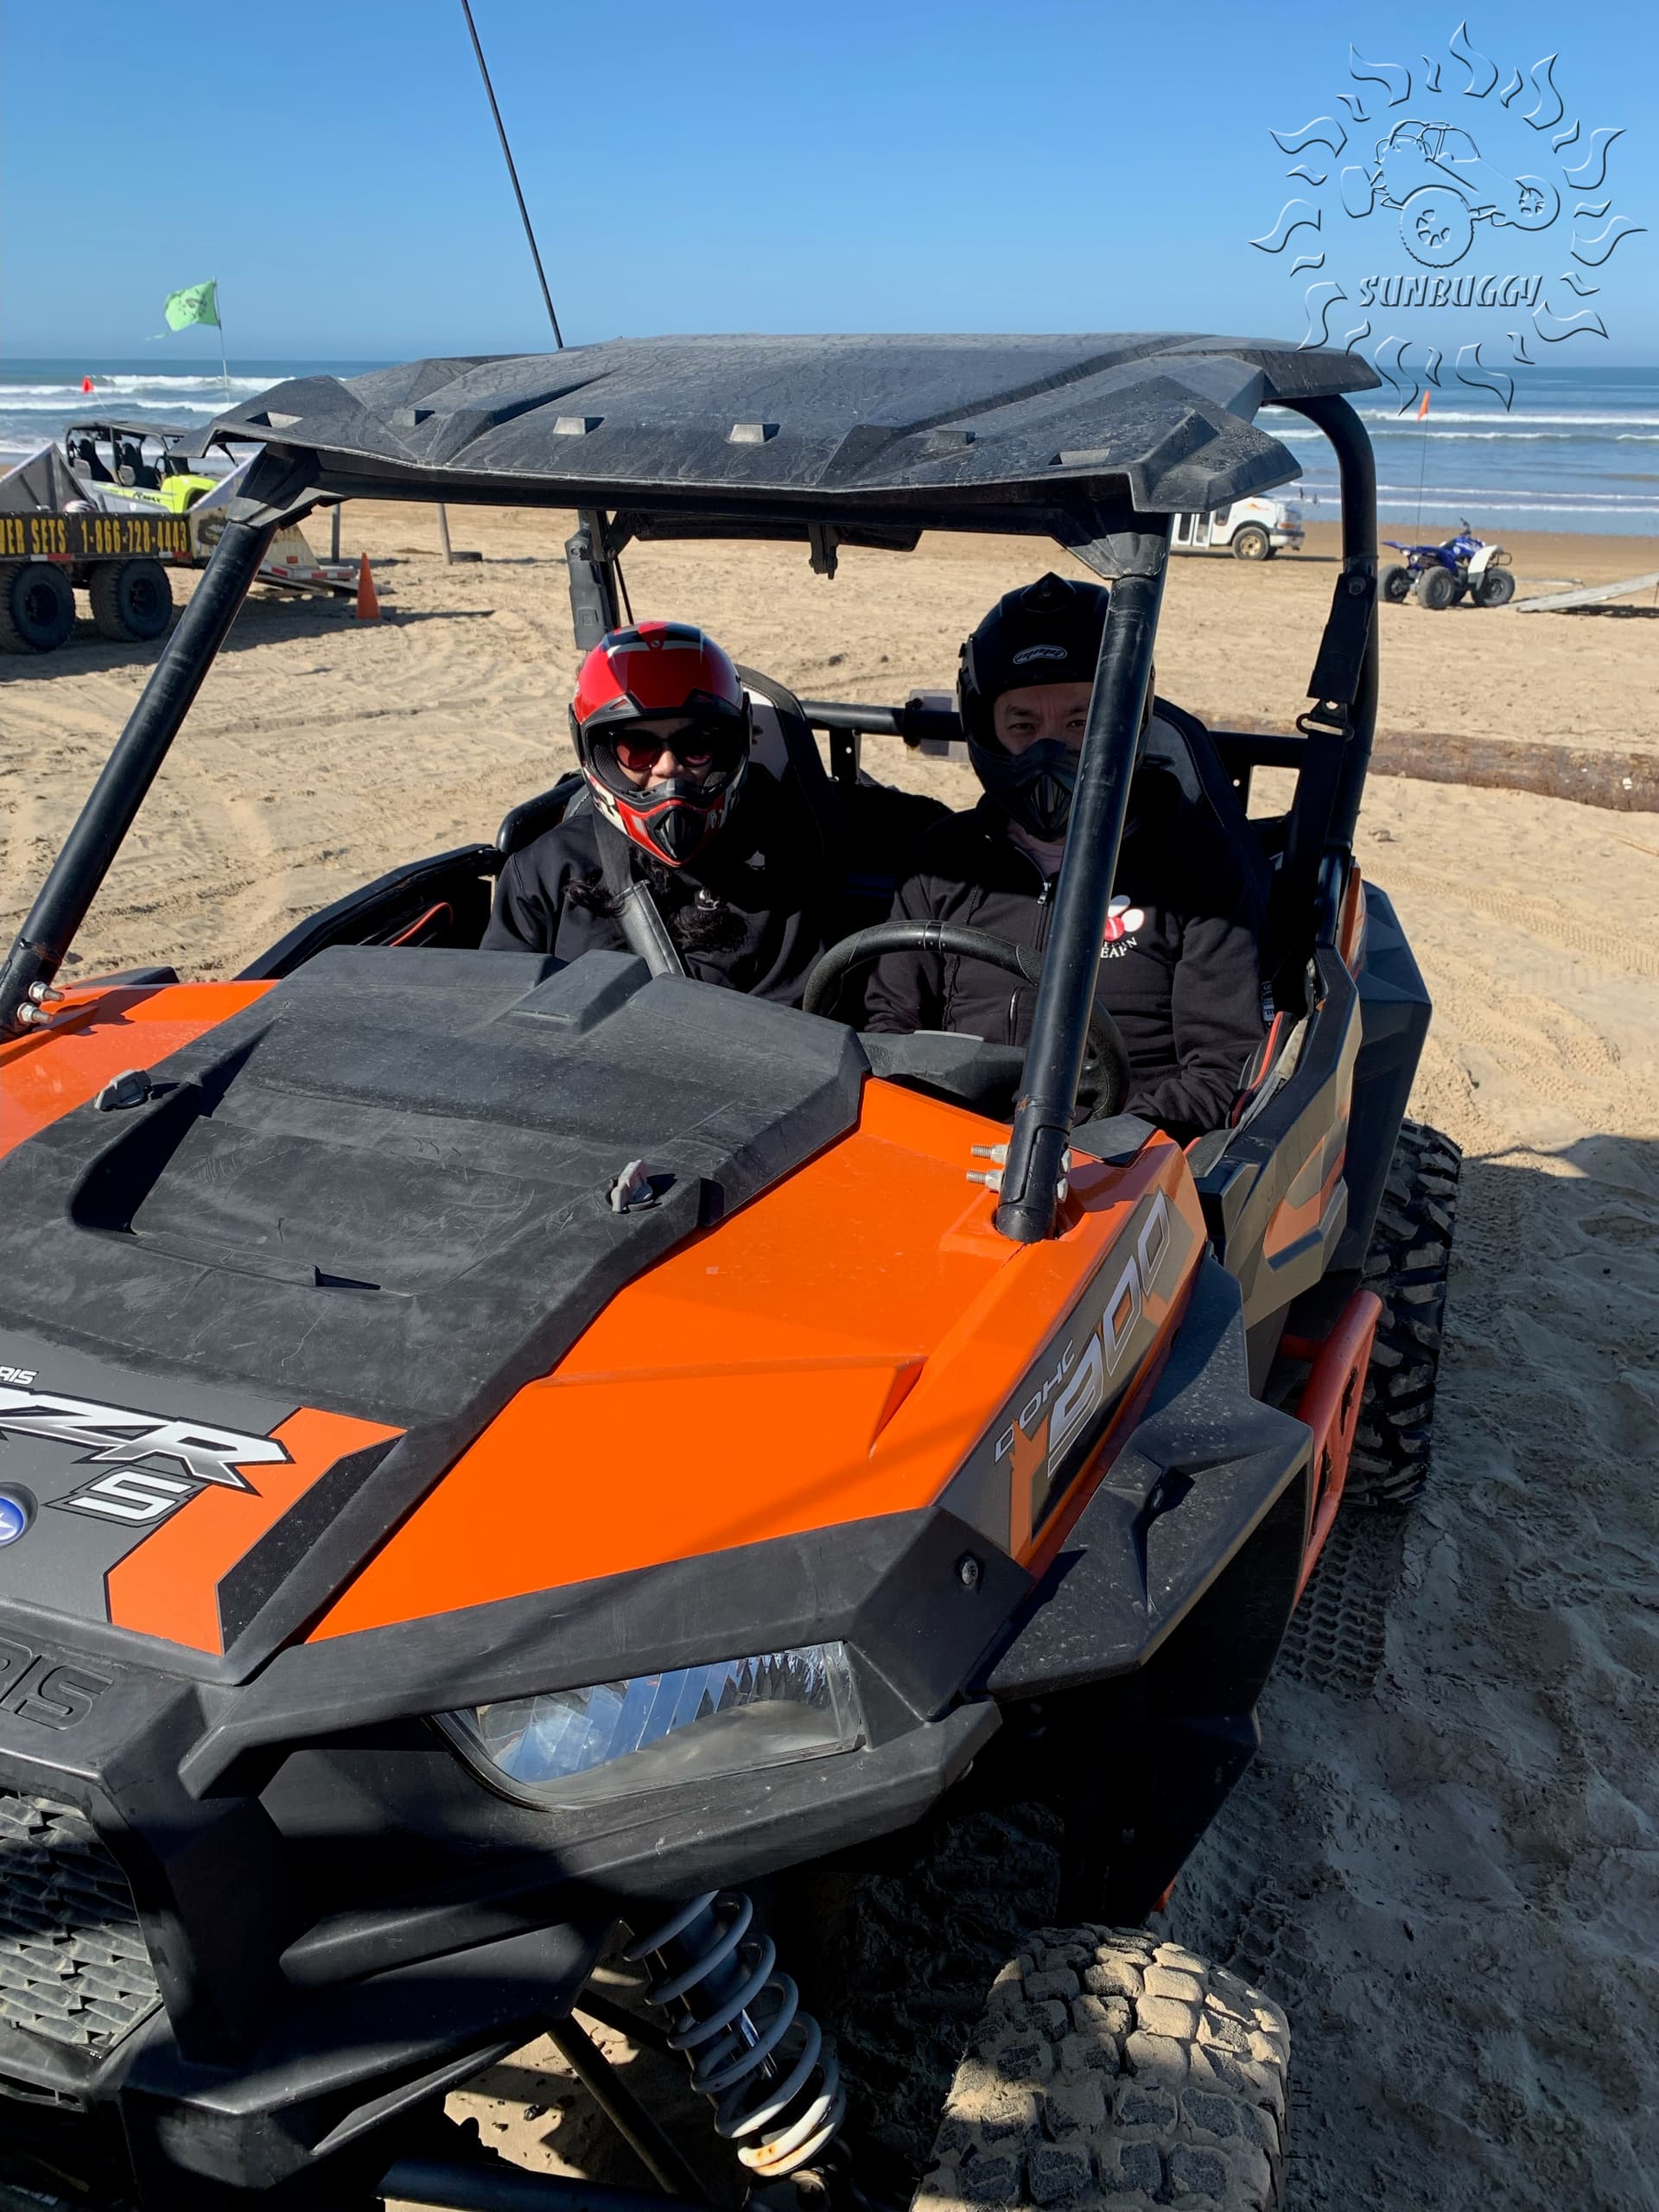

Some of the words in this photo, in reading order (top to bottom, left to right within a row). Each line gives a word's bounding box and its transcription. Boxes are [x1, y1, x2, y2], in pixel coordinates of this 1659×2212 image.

[31, 518, 67, 553] SETS
[81, 519, 188, 553] 1-866-728-4443
[1047, 1188, 1170, 1478] 900
[995, 1339, 1075, 1463] DOHC
